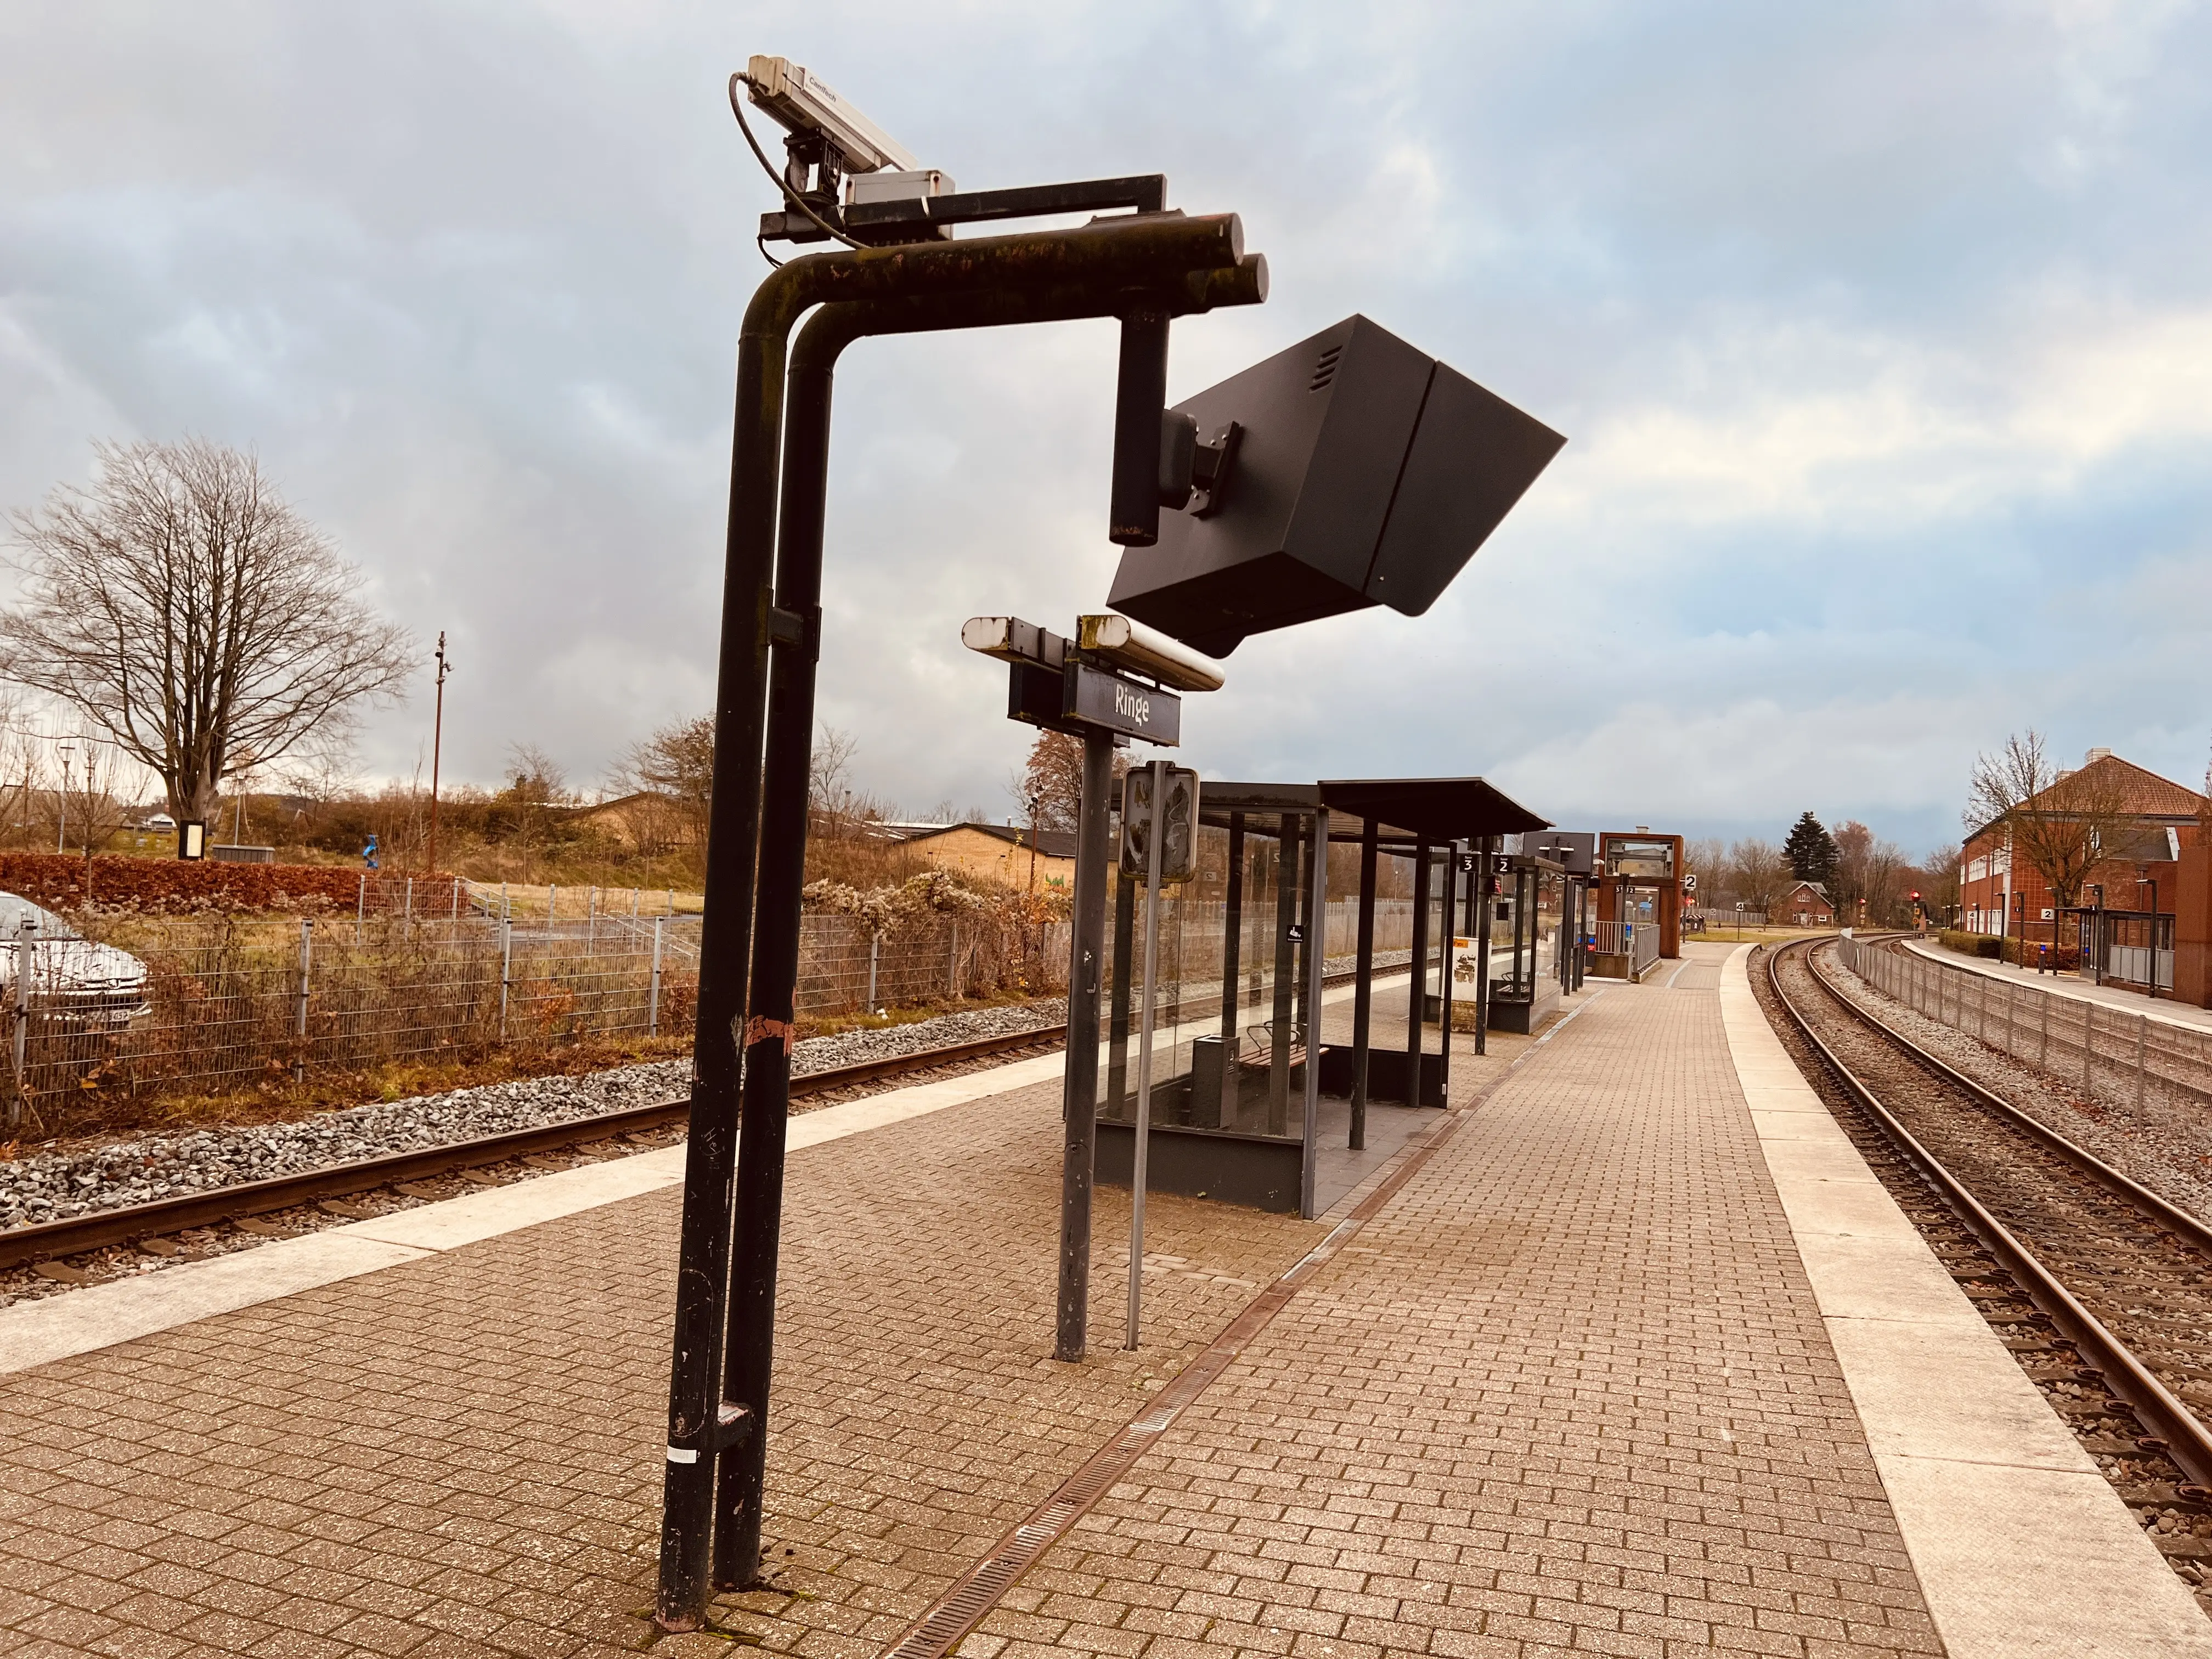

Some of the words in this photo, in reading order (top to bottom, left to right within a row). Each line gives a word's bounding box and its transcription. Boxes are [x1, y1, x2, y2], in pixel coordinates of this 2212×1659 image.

[809, 77, 836, 103] CamTech
[1115, 683, 1149, 727] Ringe
[1464, 860, 1472, 870] 3
[1499, 861, 1508, 872] 2
[1686, 876, 1695, 887] 2
